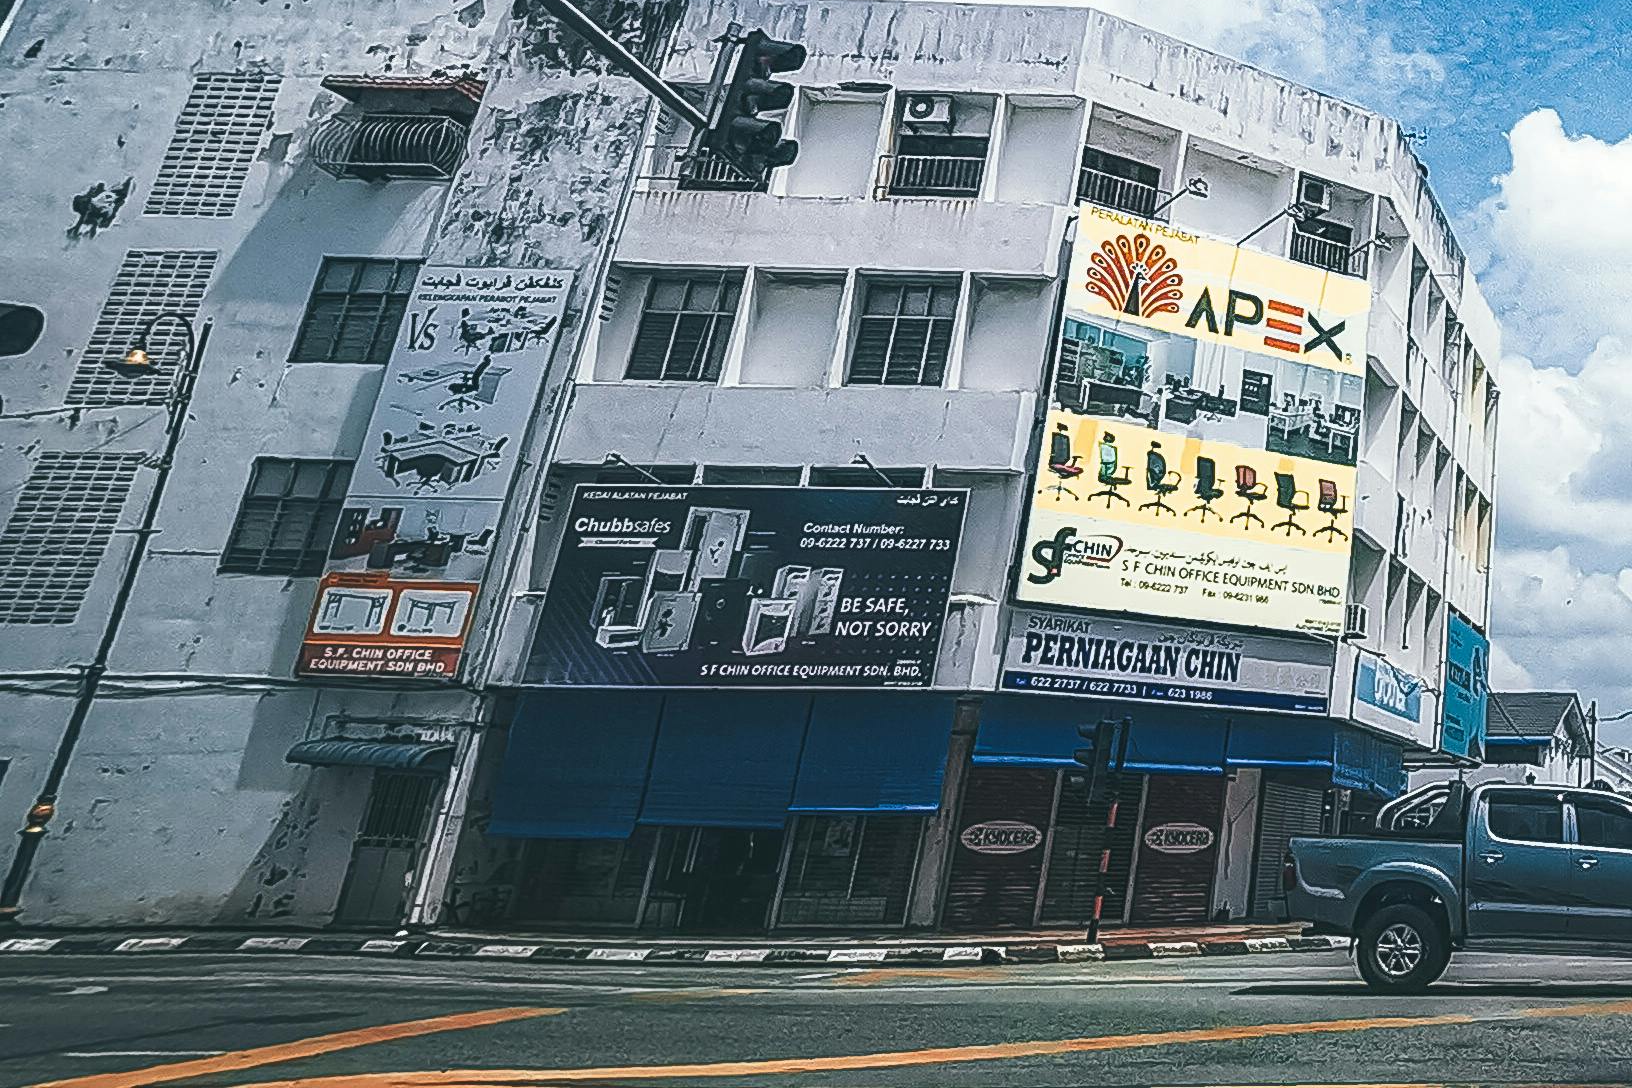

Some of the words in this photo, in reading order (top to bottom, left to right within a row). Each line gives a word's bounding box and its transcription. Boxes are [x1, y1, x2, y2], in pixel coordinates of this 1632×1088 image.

[1090, 206, 1153, 234] PERALATAN
[1154, 223, 1200, 245] PEJABAT
[479, 294, 517, 304] PERABOT
[1185, 286, 1346, 362] APEX
[611, 492, 646, 500] ALATAN
[647, 492, 688, 500] PEJABAT
[574, 516, 672, 534] Chubbsafes
[803, 522, 850, 534] Contact
[852, 523, 905, 535] Number:
[849, 538, 871, 549] 737
[929, 539, 951, 550] 733
[1073, 540, 1113, 558] CHIN
[1121, 560, 1130, 571] S
[1133, 561, 1141, 572] F
[1145, 563, 1176, 579] CHIN
[1178, 567, 1220, 584] OFFICE
[1222, 572, 1290, 592] EQUIPMENT
[1291, 582, 1315, 595] SDN
[1173, 584, 1188, 594] 737
[840, 598, 864, 613] BE
[865, 598, 910, 615] SAFE,
[834, 621, 875, 636] NOT
[876, 621, 932, 637] SORRY
[1027, 615, 1092, 634] SYARIKAT
[323, 647, 349, 659] S.F.
[351, 648, 383, 660] CHIN
[386, 649, 433, 661] OFFICE
[1021, 630, 1182, 677] PERNIAGAAN
[1184, 649, 1242, 683] CHIN
[309, 658, 384, 672] EQUIPMENT
[385, 661, 413, 672] SDN
[416, 662, 445, 673] BHD
[700, 664, 710, 676] S
[710, 664, 718, 676] F
[719, 664, 750, 676] CHIN
[751, 665, 790, 677] OFFICE
[792, 665, 862, 679] EQUIPMENT
[864, 665, 891, 677] SDN.
[893, 665, 922, 677] BHD.
[1031, 676, 1051, 688] 622
[1053, 678, 1081, 691] 2737
[1089, 681, 1109, 693] 622
[1112, 683, 1137, 695] 7733
[1167, 688, 1187, 699] 623
